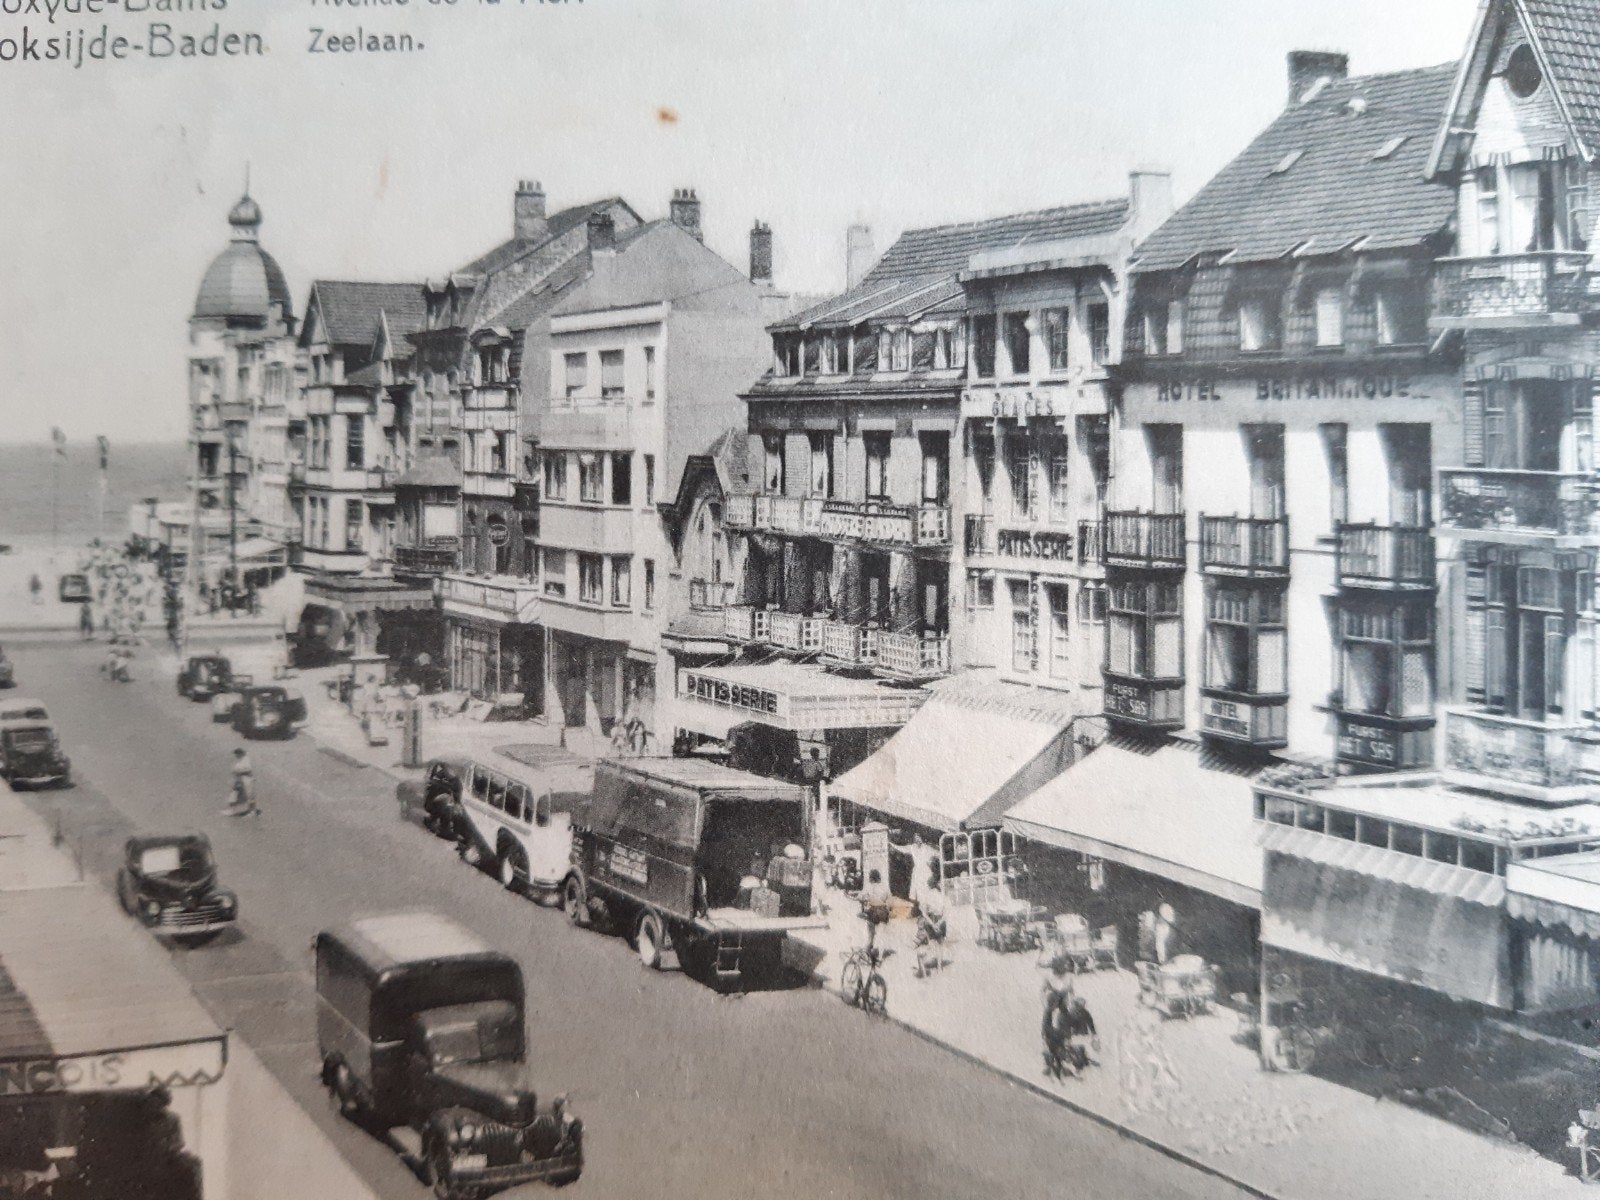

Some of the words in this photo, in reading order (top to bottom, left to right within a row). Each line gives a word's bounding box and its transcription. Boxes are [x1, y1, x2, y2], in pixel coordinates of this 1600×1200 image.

[0, 23, 264, 69] oksijde-Baden
[308, 26, 425, 53] Zeelaan.
[1157, 382, 1221, 401] HOTEL
[1029, 443, 1039, 521] OTEL
[686, 674, 778, 714] PATISSERIE
